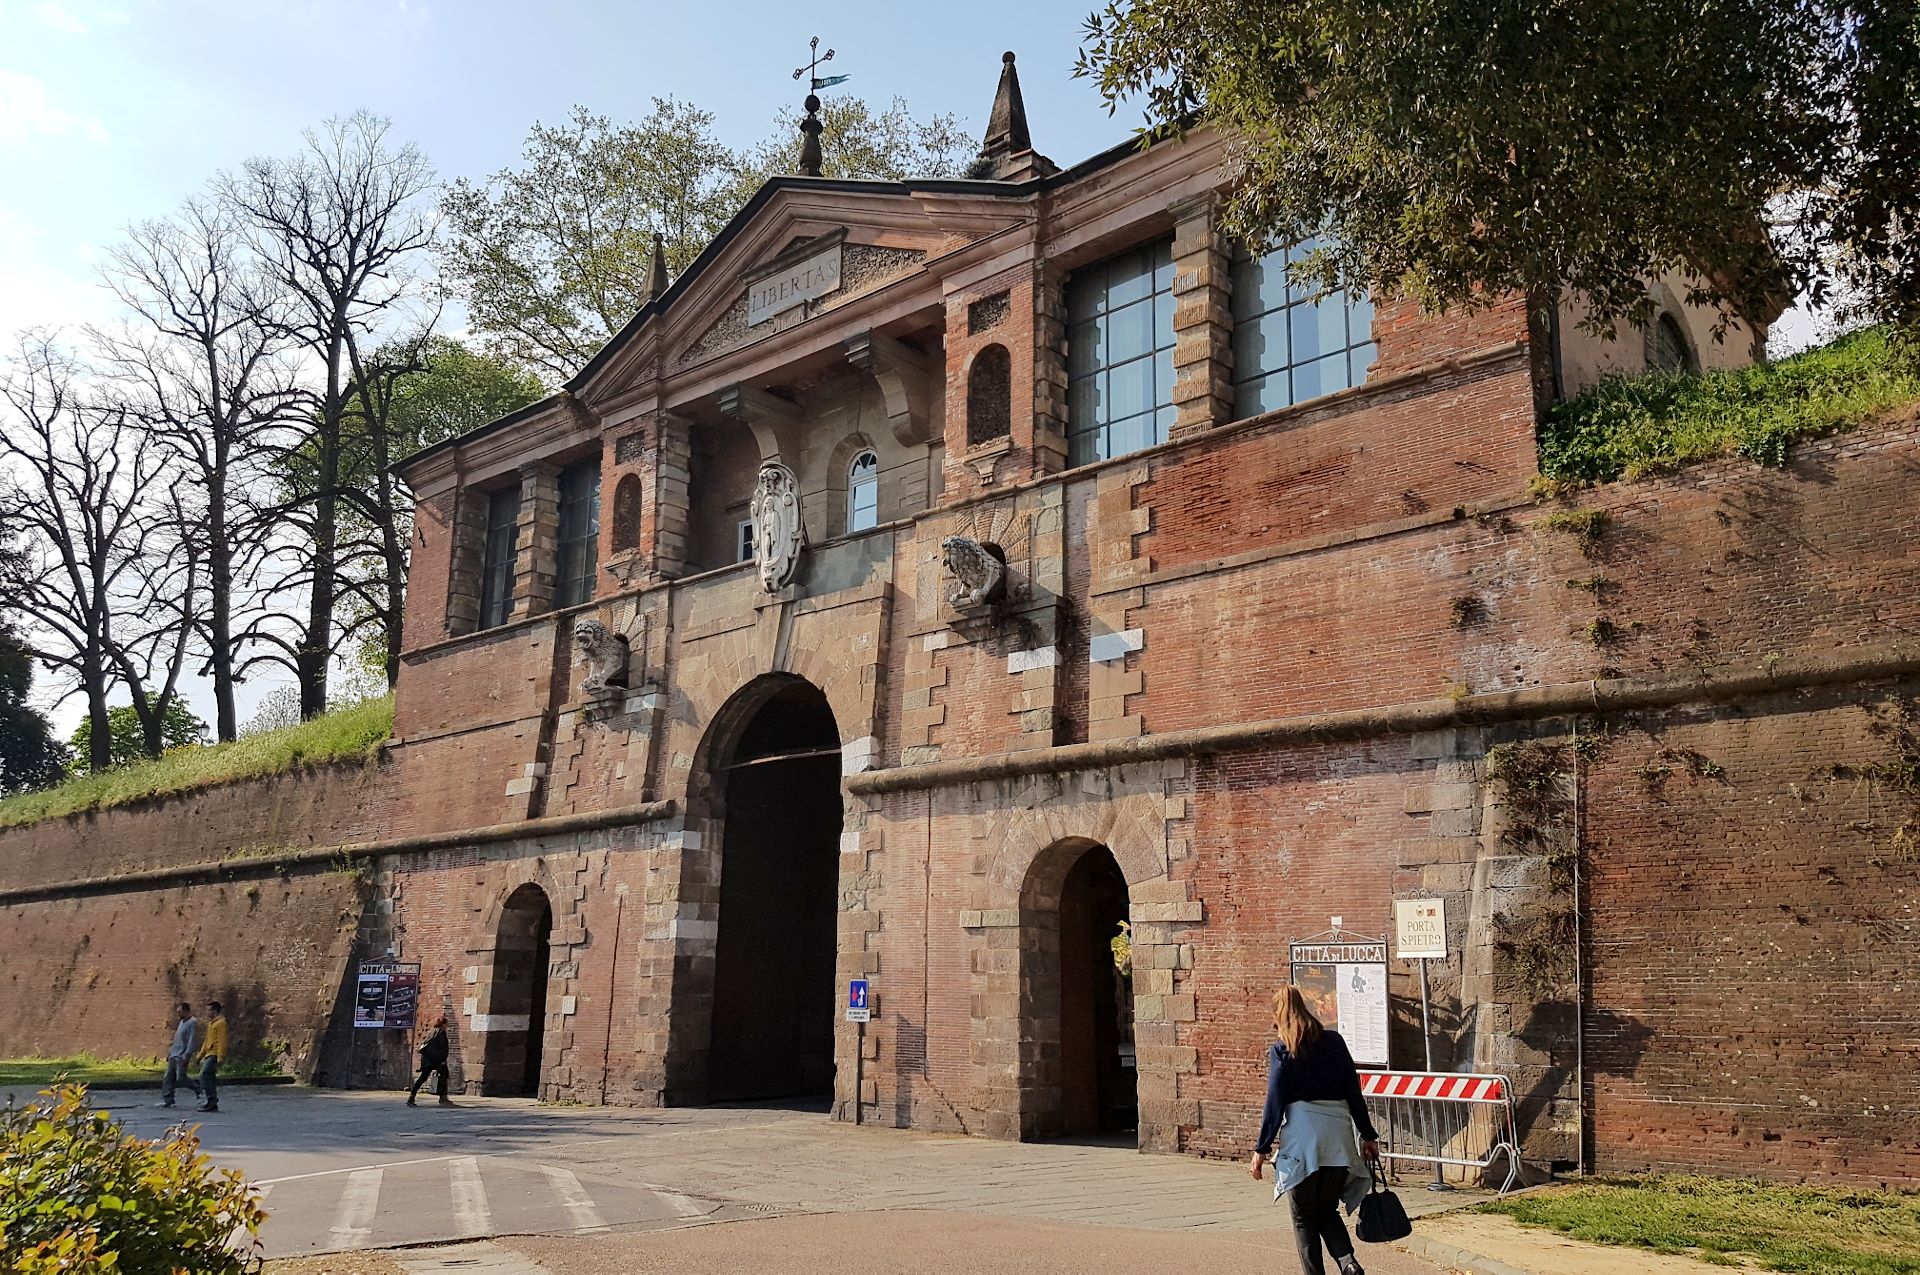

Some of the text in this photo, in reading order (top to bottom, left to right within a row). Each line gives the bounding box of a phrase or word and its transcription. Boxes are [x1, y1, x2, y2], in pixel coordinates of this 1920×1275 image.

[751, 259, 838, 312] LIBERTAS
[1407, 920, 1436, 932] PORTA
[1332, 953, 1340, 962] DI
[1341, 946, 1382, 962] LUCCA
